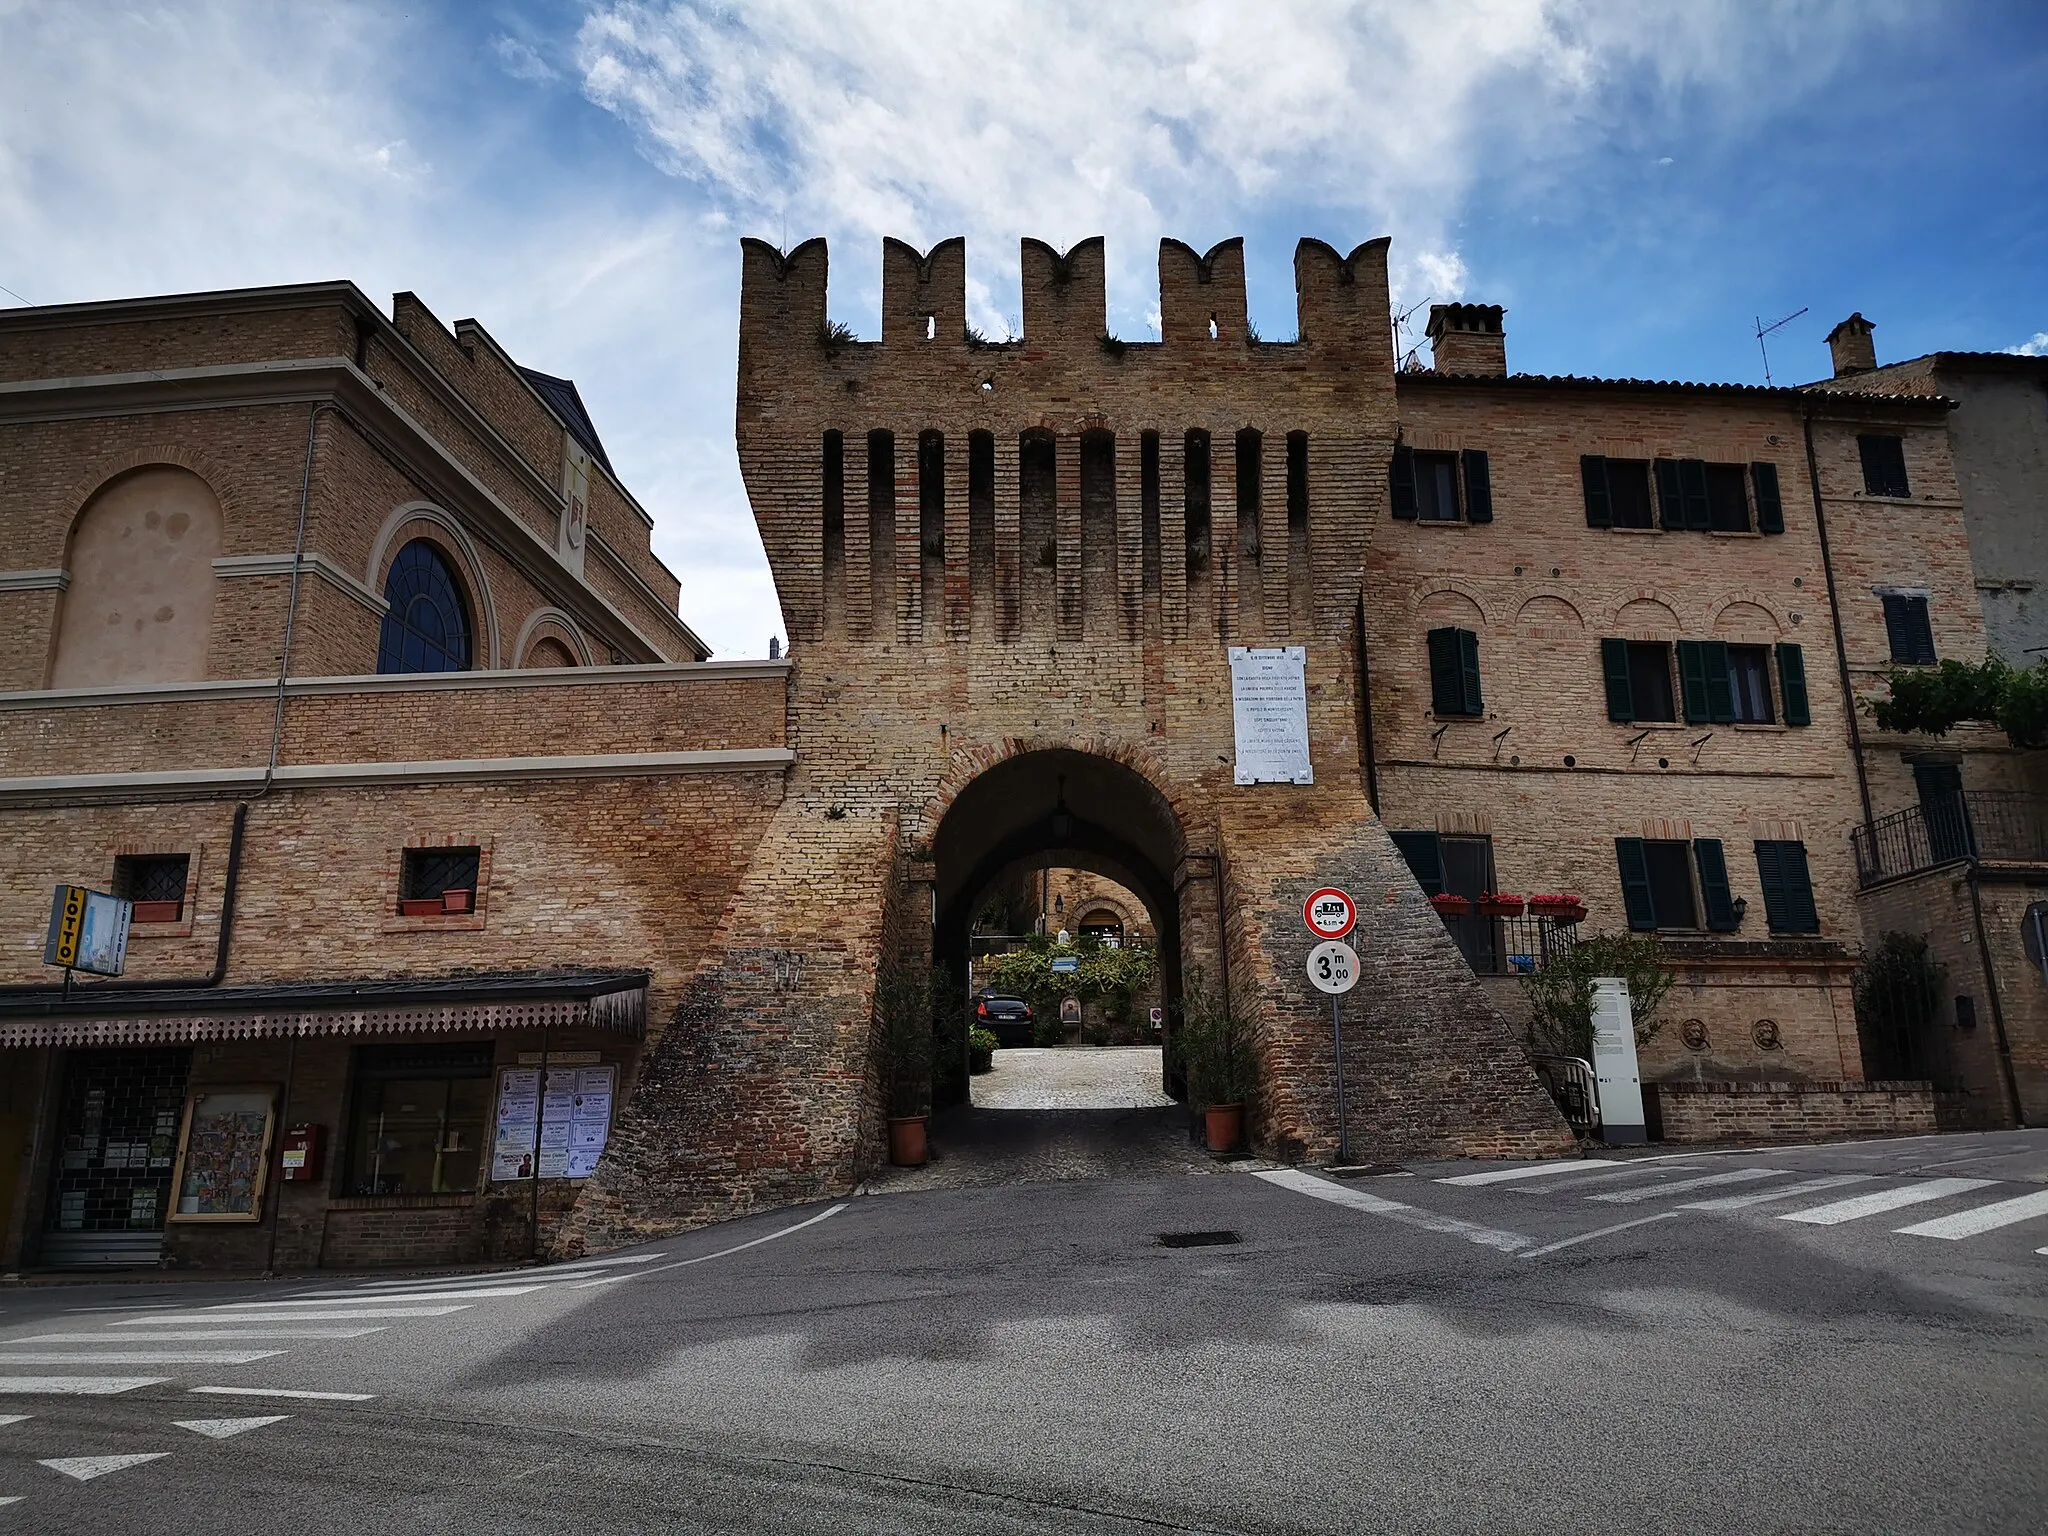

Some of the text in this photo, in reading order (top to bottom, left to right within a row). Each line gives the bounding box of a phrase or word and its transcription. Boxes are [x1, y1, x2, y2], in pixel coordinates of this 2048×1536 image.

[60, 889, 79, 959] LOTTO
[114, 902, 128, 973] EDICOLA
[1334, 955, 1345, 964] m
